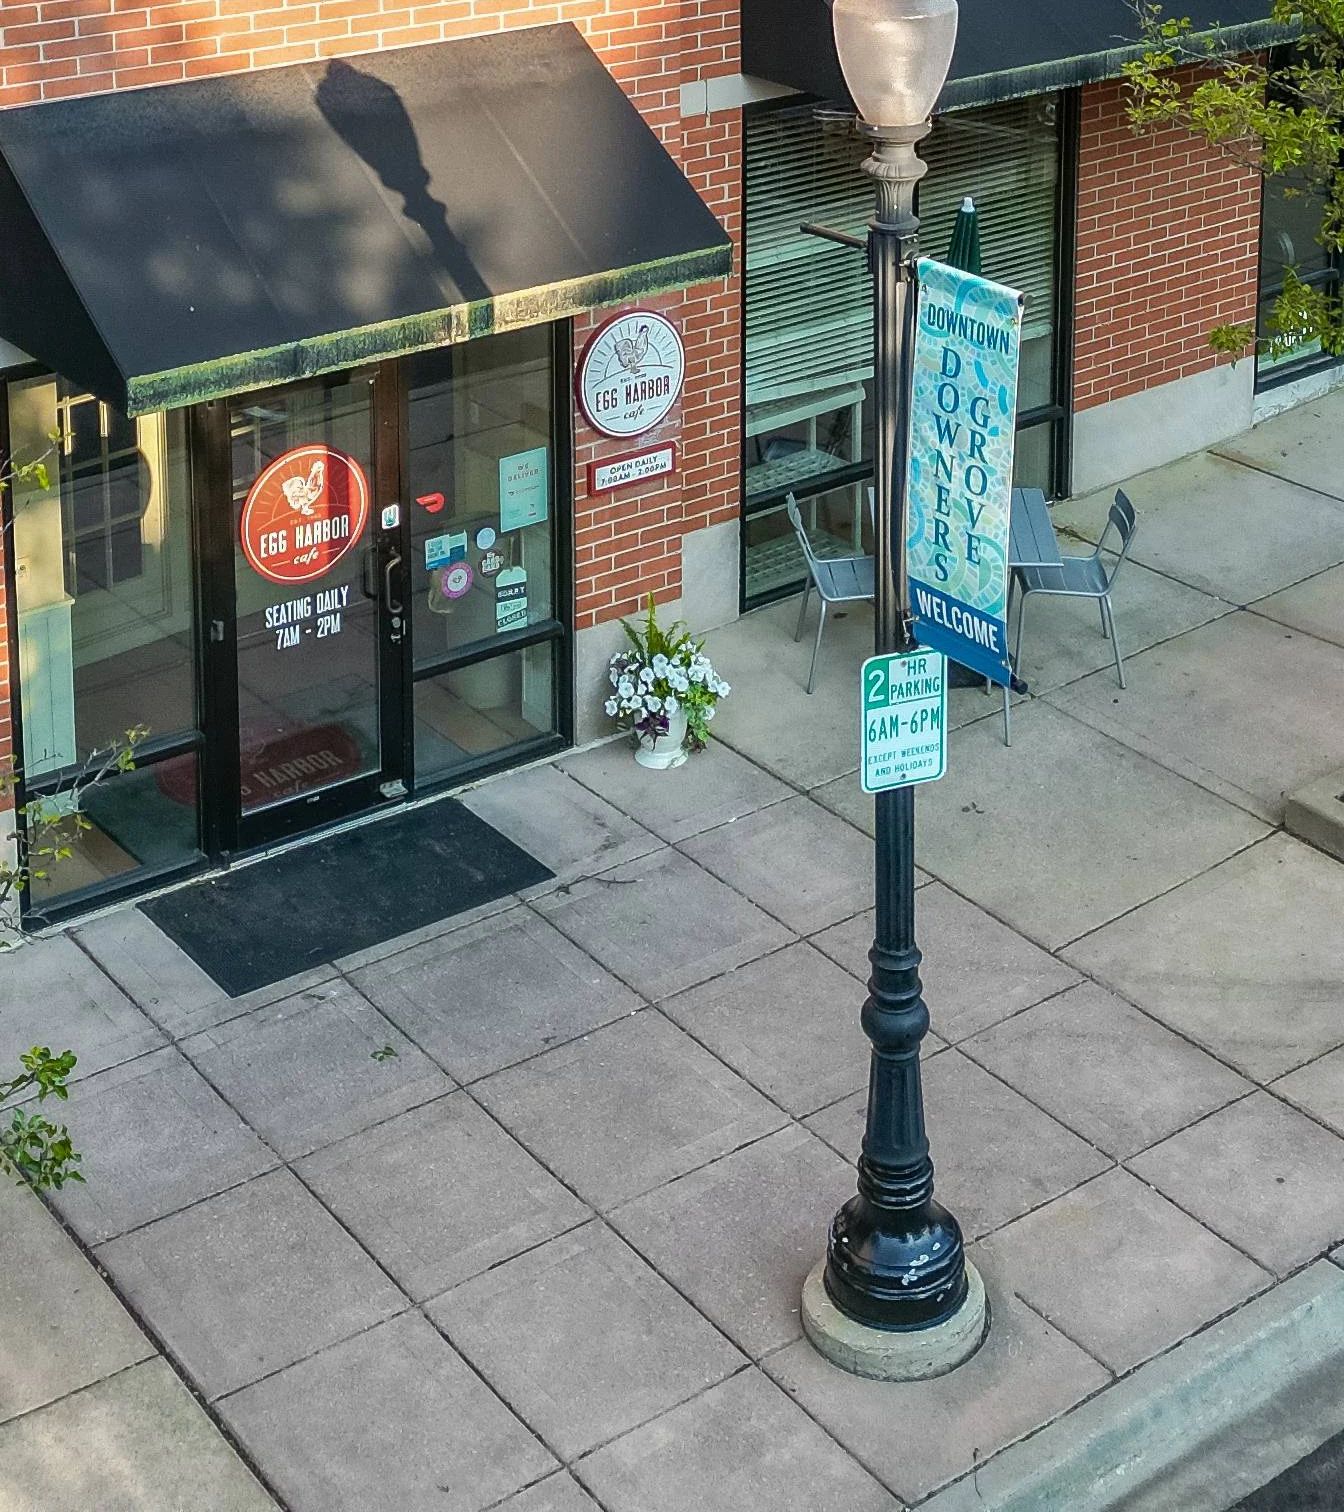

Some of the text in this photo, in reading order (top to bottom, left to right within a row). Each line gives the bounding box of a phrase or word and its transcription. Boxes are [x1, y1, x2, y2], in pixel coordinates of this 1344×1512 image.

[927, 303, 1010, 355] DOWNTOWN
[595, 375, 670, 413] EGG HARBOR
[623, 404, 645, 421] cafe
[609, 455, 658, 475] OPEN DAILY
[932, 345, 963, 583] DOWNERS
[964, 396, 992, 566] GROVE
[260, 514, 350, 559] EGG HARBOR
[293, 547, 320, 565] cafe
[265, 585, 349, 629] SEATING DAILY
[497, 609, 526, 627] CLOSED
[915, 588, 1000, 654] WELCOME
[275, 624, 300, 651] 7AM
[316, 613, 341, 639] 2PM
[868, 658, 927, 703] 2 HR
[890, 676, 940, 701] PARKING
[868, 706, 940, 742] 6AM-6PM
[254, 750, 344, 788] HARBOR
[868, 742, 940, 765] EXCEPT WEEKENDS
[875, 758, 933, 777] AND HOLIDAYS
